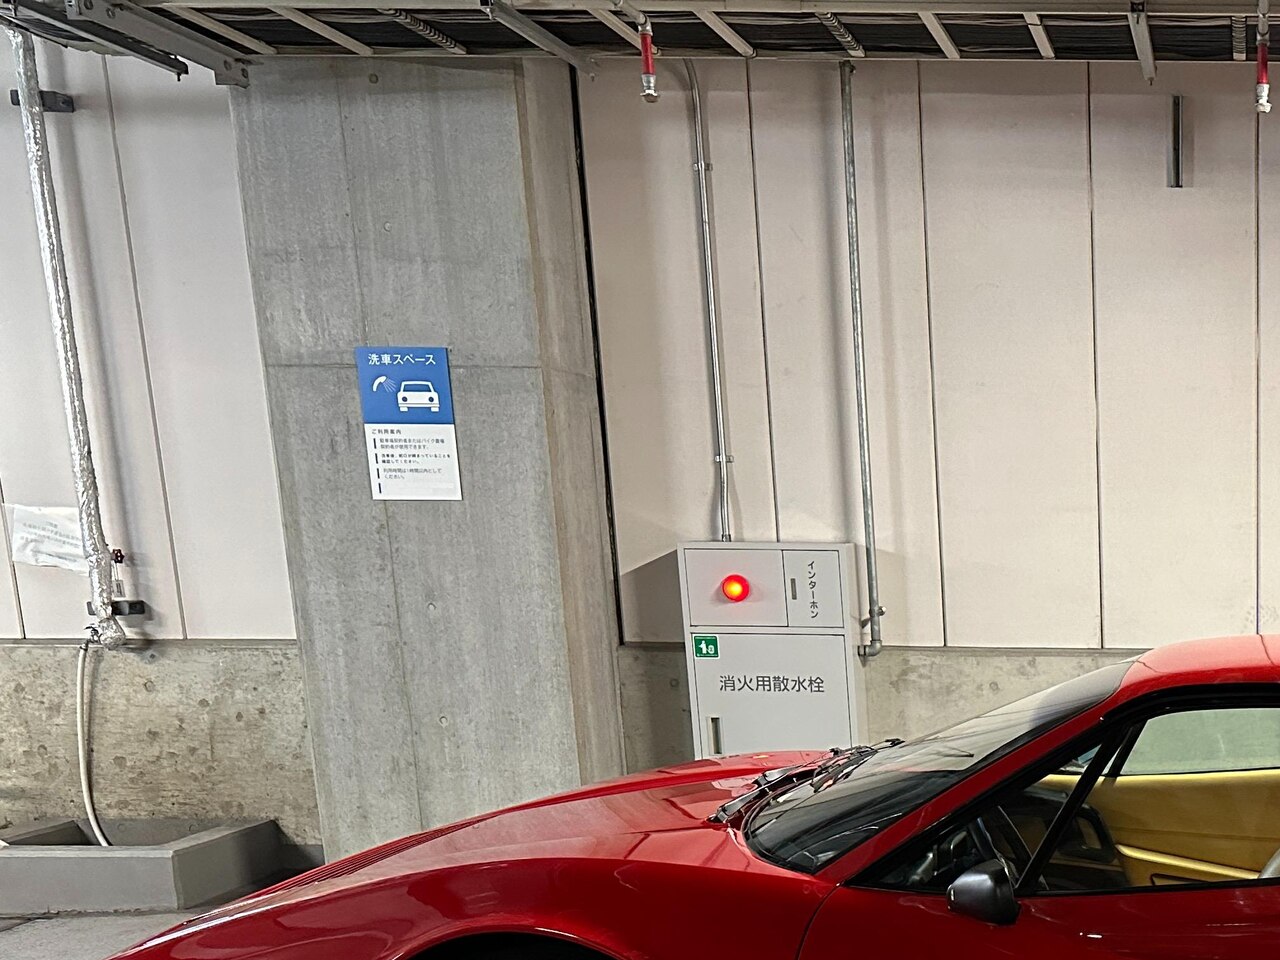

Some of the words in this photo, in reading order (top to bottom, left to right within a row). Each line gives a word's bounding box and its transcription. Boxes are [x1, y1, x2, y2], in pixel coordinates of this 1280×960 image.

[367, 353, 436, 366] 洗車スペース
[807, 560, 819, 619] インターホン
[719, 675, 825, 693] 消火用散水栓
